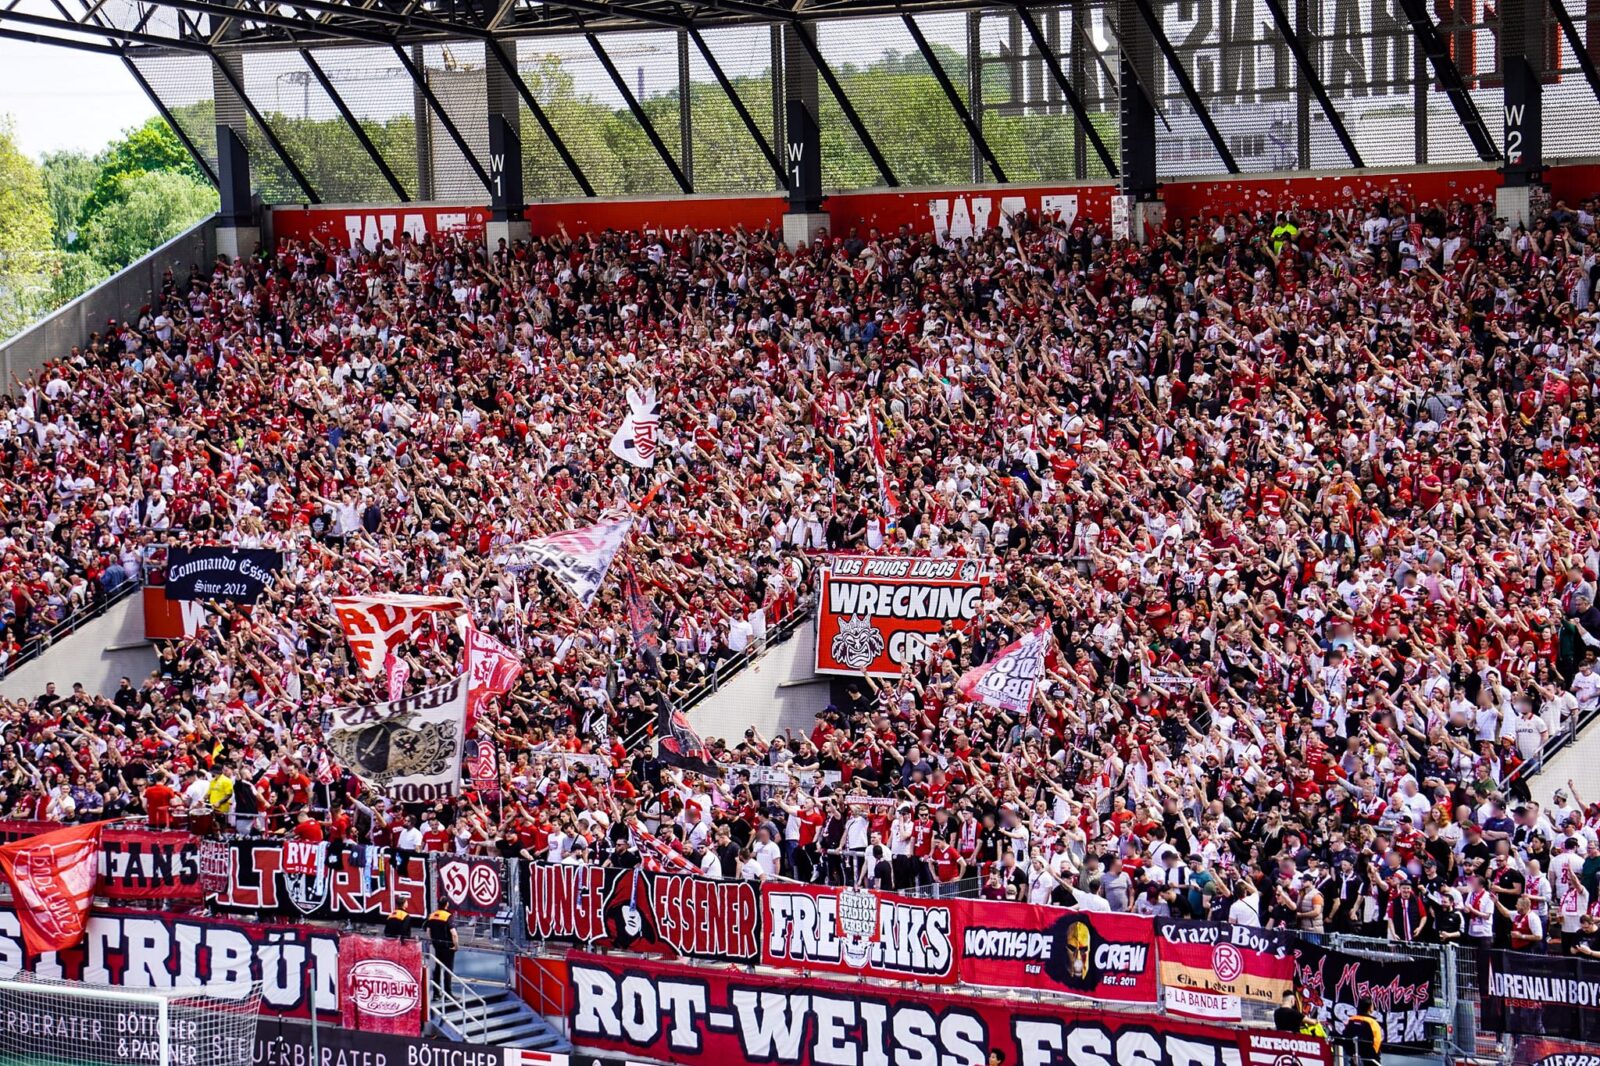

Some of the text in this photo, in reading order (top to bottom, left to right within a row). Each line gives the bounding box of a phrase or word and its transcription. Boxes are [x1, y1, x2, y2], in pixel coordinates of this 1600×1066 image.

[1504, 104, 1525, 155] W 2
[490, 153, 505, 197] W 1
[787, 142, 804, 188] W 1
[169, 555, 275, 587] Commando Essen
[834, 559, 864, 575] LOS
[910, 560, 958, 578] LOCOS
[194, 579, 248, 596] Since 2012
[830, 582, 982, 620] WRECKING
[889, 630, 940, 664] CRE
[103, 841, 200, 888] FANS
[526, 862, 605, 941] JUNGE
[653, 875, 759, 958] ESSENER
[839, 905, 877, 922] STADION
[965, 929, 1147, 972] NORTHSIDE CREW
[1103, 975, 1136, 987] EST. 2011
[1335, 961, 1430, 1013] Mambas
[1488, 960, 1600, 1007] ADRENALIN BOY
[573, 965, 988, 1066] ROT-WEISS
[1174, 993, 1186, 1004] LA
[1190, 994, 1219, 1010] BANDA
[3, 1011, 102, 1042] RBERATER
[118, 1011, 197, 1041] BÖTTHER
[1317, 997, 1427, 1043] ESEN
[118, 1038, 197, 1065] & PARNER
[407, 1043, 497, 1066] BÖTTCHER
[1249, 1035, 1321, 1056] KATEGORIE
